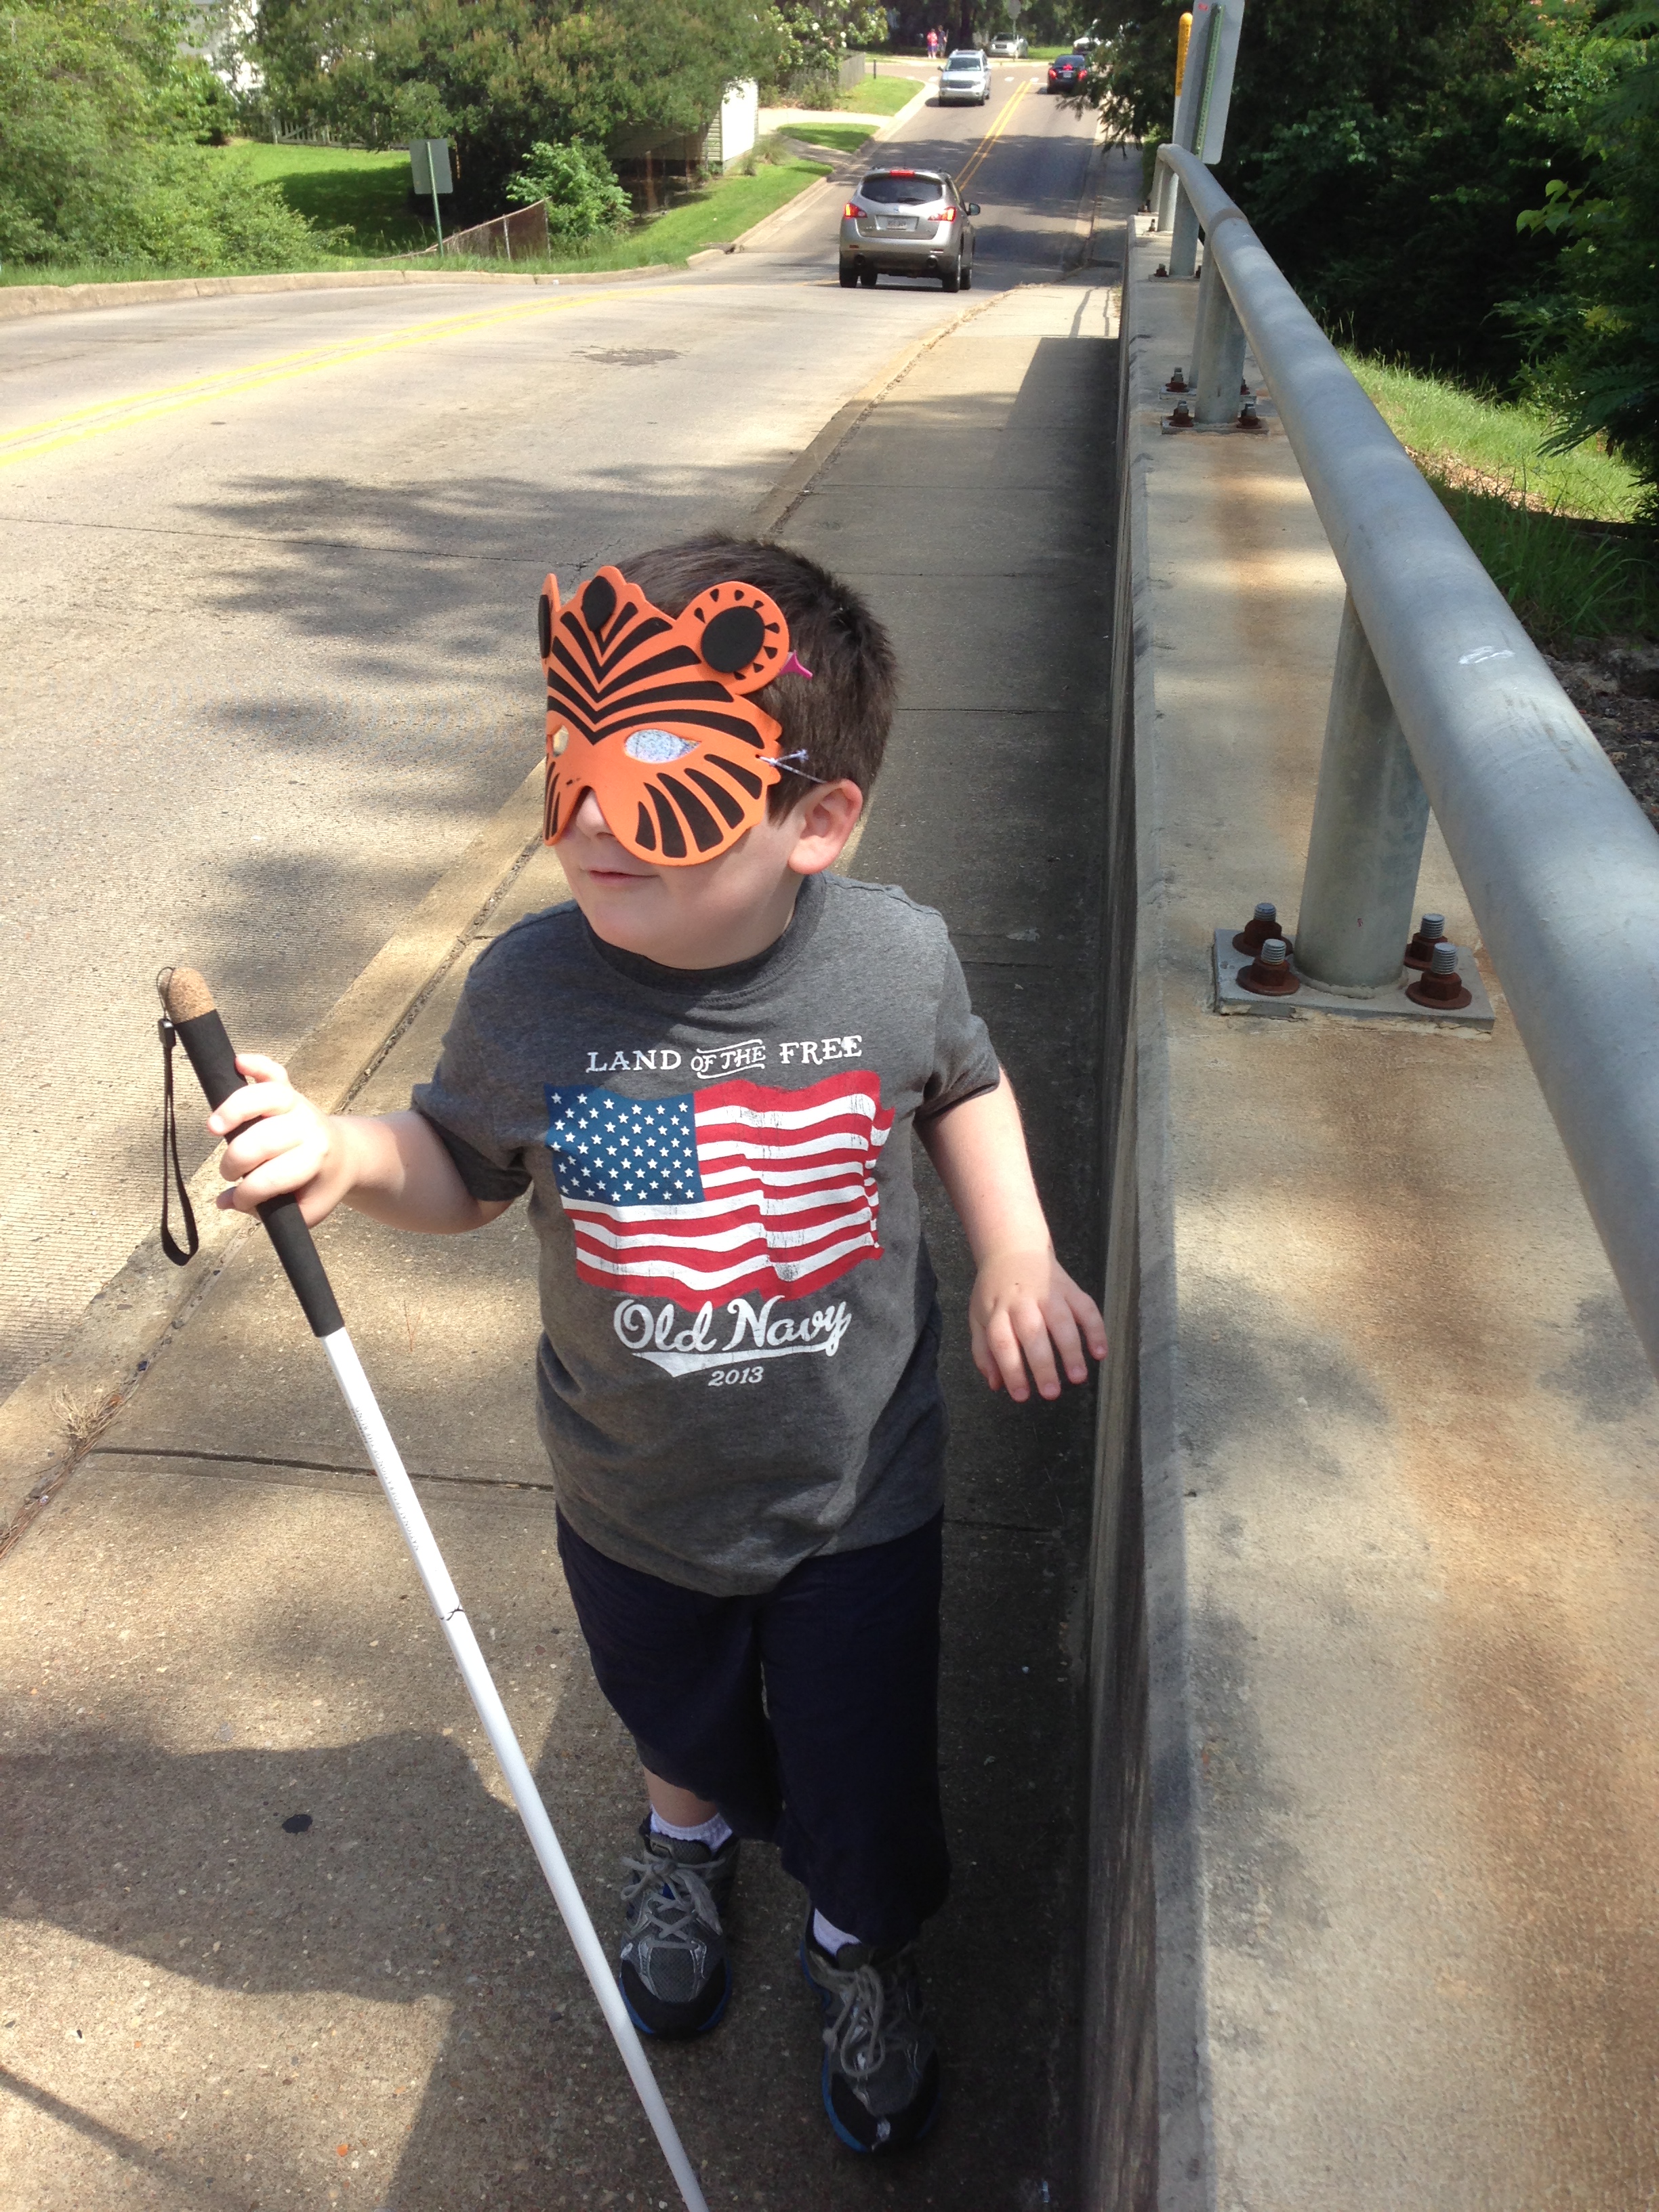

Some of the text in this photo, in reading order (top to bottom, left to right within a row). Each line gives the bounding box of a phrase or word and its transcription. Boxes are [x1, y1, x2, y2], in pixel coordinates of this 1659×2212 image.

[586, 1035, 862, 1073] LAND OF THE FREE
[613, 1295, 852, 1356] Old Navy
[708, 1366, 764, 1387] 2013
